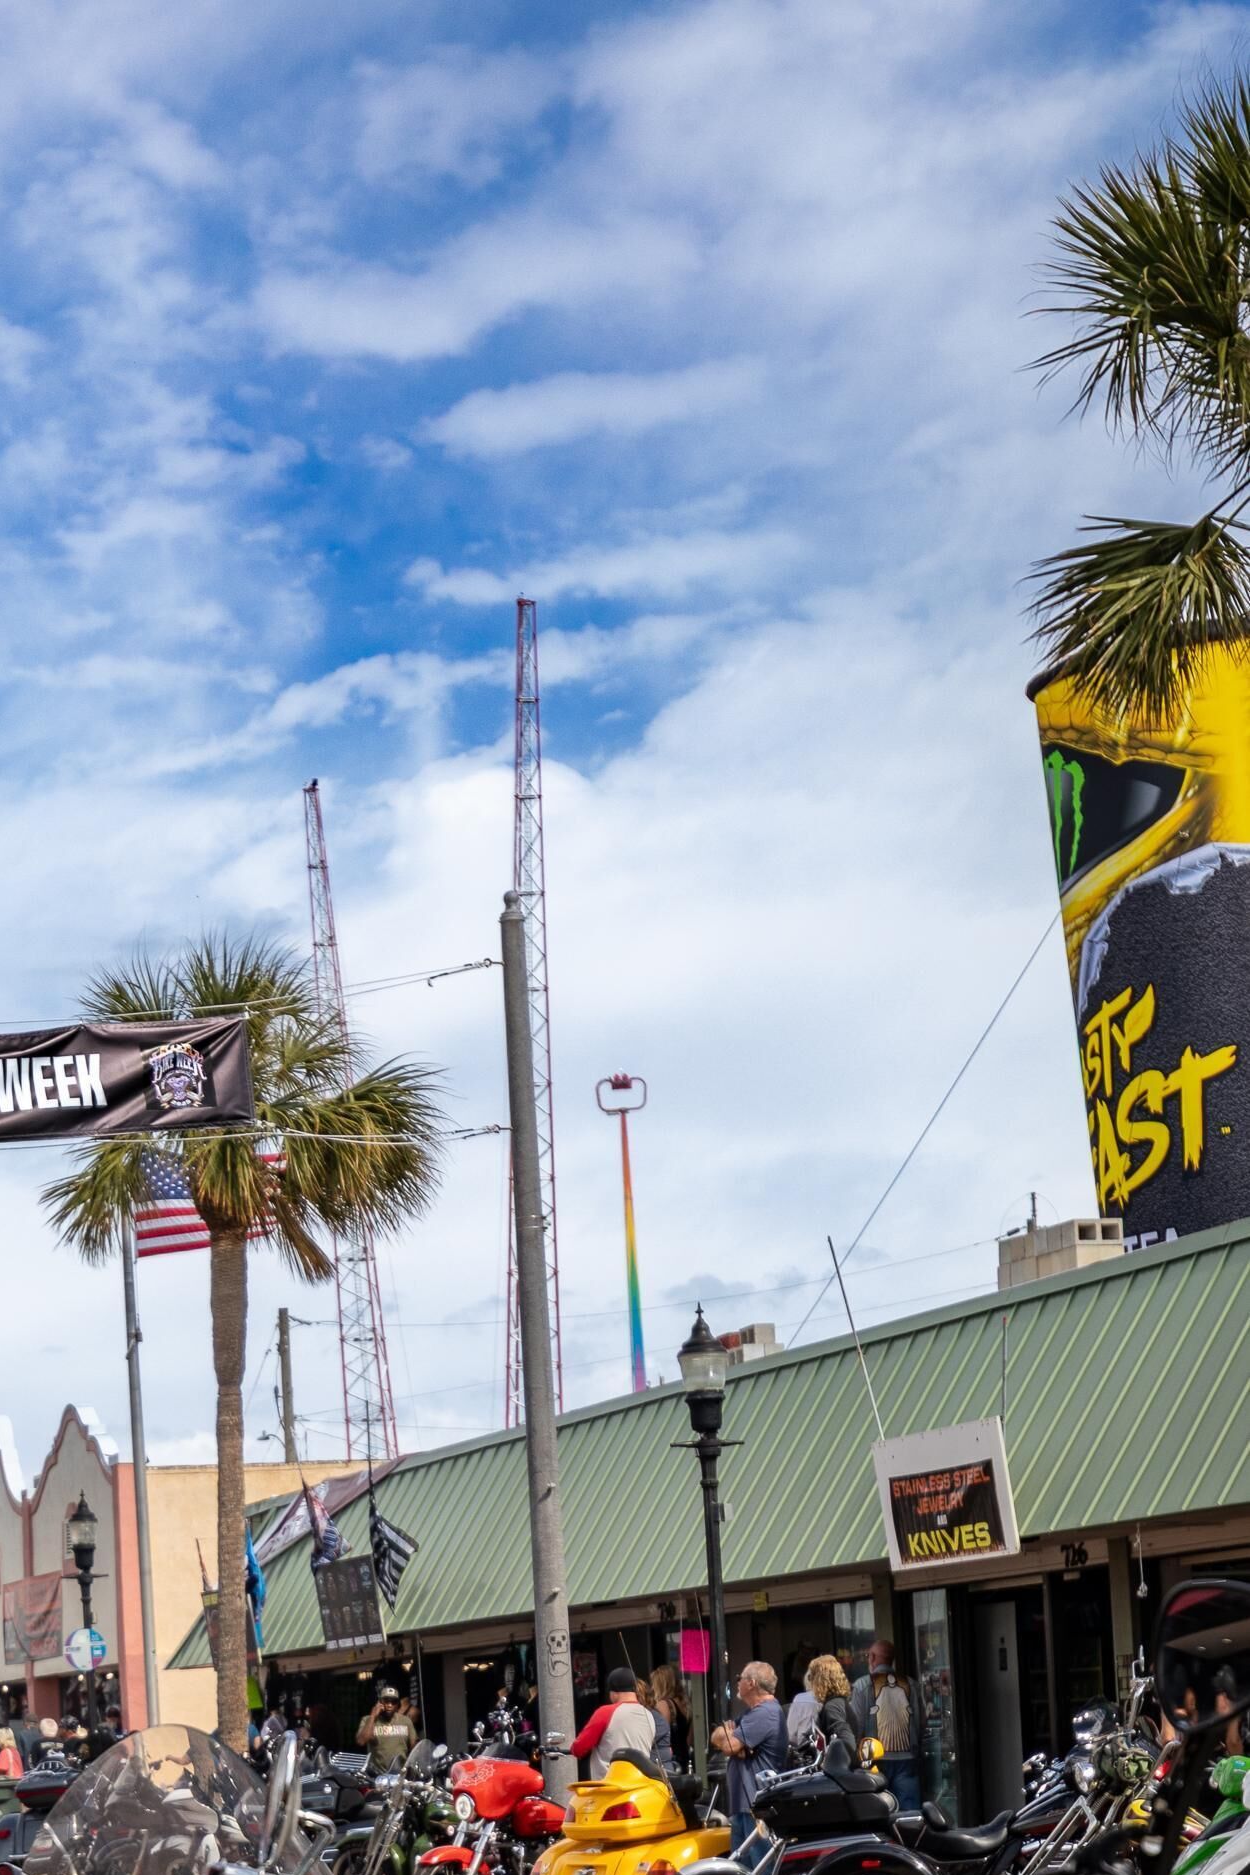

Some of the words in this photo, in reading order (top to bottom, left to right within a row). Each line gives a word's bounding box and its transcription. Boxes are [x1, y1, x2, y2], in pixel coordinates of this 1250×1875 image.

[1081, 984, 1155, 1097] STY
[1089, 1045, 1237, 1214] AST
[893, 1473, 950, 1497] STAINLESS
[953, 1466, 990, 1488] STEEL
[916, 1490, 965, 1515] JEWELRY
[907, 1521, 992, 1557] KNIVES
